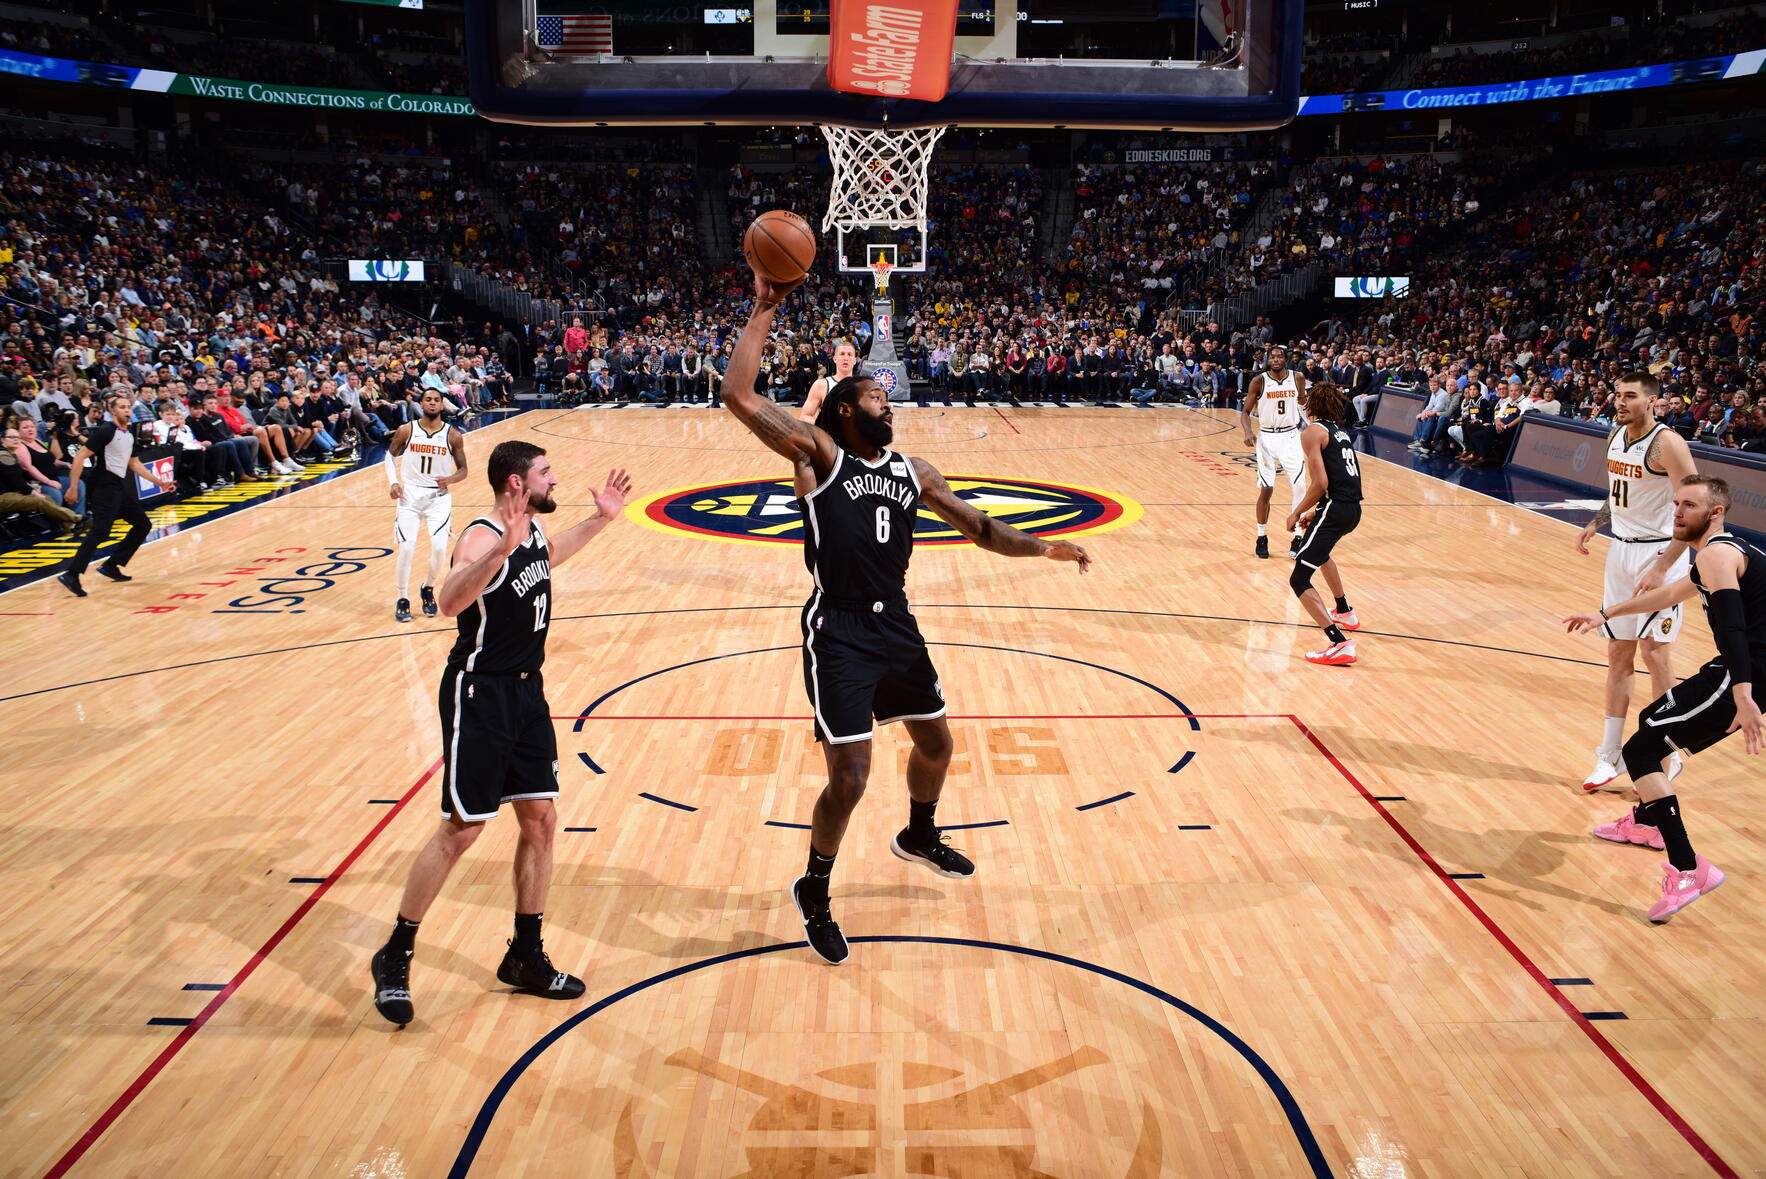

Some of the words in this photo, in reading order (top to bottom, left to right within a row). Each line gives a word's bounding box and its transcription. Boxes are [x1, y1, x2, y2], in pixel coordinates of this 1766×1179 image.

[369, 97, 383, 109] of
[1403, 89, 1482, 109] Connect
[1486, 80, 1529, 104] with
[1533, 77, 1564, 99] the
[1125, 149, 1211, 162] EDDIESKIDS.ORG
[1266, 389, 1296, 399] NUGGETS
[1277, 400, 1285, 415] 9
[410, 443, 447, 456] NUGGETS
[420, 455, 433, 475] 11
[842, 473, 915, 511] BROOKLYN
[1612, 479, 1629, 508] 41
[875, 505, 890, 544] 6
[130, 547, 307, 615] CENTER
[210, 547, 394, 614] pepsi
[511, 559, 550, 598] BROOKL
[533, 592, 547, 633] 12
